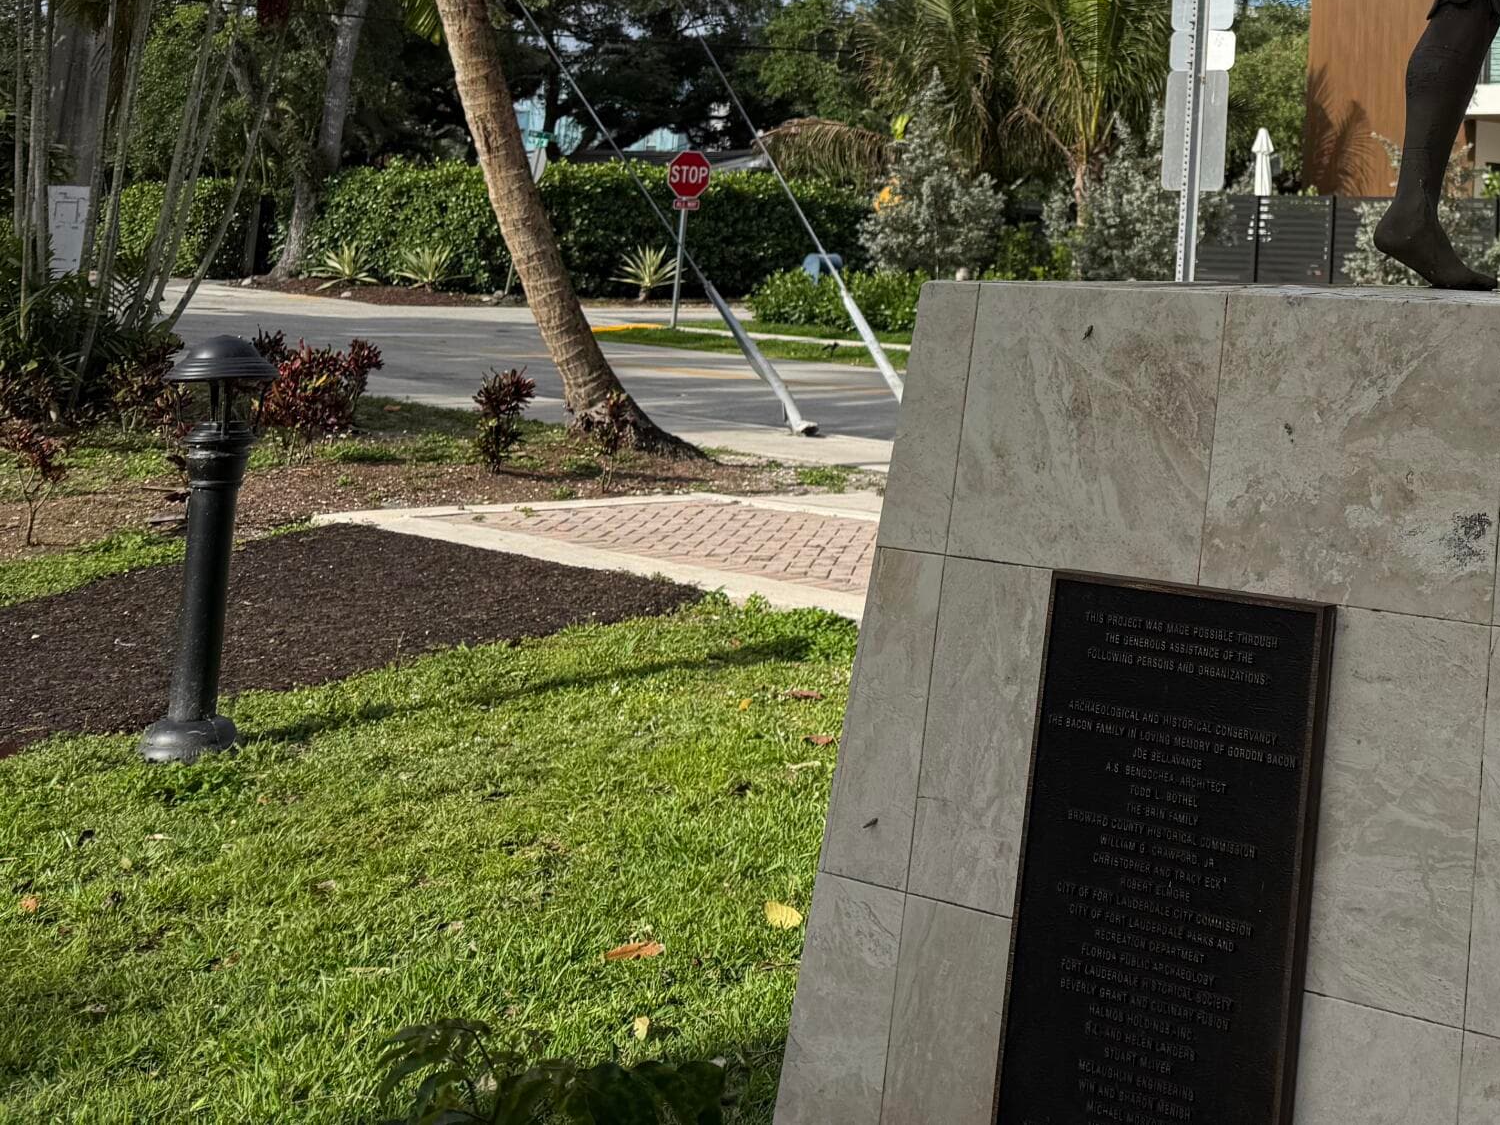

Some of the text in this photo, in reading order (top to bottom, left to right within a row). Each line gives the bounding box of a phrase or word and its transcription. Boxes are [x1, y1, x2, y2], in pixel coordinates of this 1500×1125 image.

[671, 165, 708, 184] STOP
[1085, 611, 1104, 622] THIS
[1107, 614, 1142, 628] PROJECT
[1144, 619, 1162, 631] WAS
[1166, 622, 1189, 635] MADE
[1192, 626, 1233, 641] POSSIBLE
[1104, 632, 1253, 663] THE GENEROUS ASSISTANCE OF THE
[1087, 648, 1133, 664] FOLLOWING
[1136, 655, 1174, 670] PERSONS
[1177, 661, 1194, 673] AND
[1142, 712, 1159, 724] AND
[1048, 714, 1062, 725] THE
[1095, 722, 1124, 736] FAMILY
[1127, 727, 1136, 738] IN
[1139, 729, 1170, 744] LOVING
[1213, 743, 1224, 754] OF
[1227, 745, 1263, 761] GORDON
[1132, 746, 1147, 759] JOE
[1111, 818, 1144, 834] COUNTY
[1127, 802, 1141, 814] THE
[1168, 810, 1198, 826] FAMILY
[1153, 865, 1171, 878] AND
[1056, 881, 1076, 895] CITY
[1078, 886, 1089, 898] OF
[1092, 889, 1113, 904] FORT
[1115, 894, 1170, 917] LAUDERDALE
[1173, 907, 1193, 922] CITY
[1069, 903, 1087, 917] CITY
[1090, 908, 1101, 920] OF
[1104, 911, 1126, 926] FORT
[1128, 917, 1183, 939] LAUDERDALE
[1216, 938, 1234, 952] AND
[1130, 994, 1148, 1009] AND
